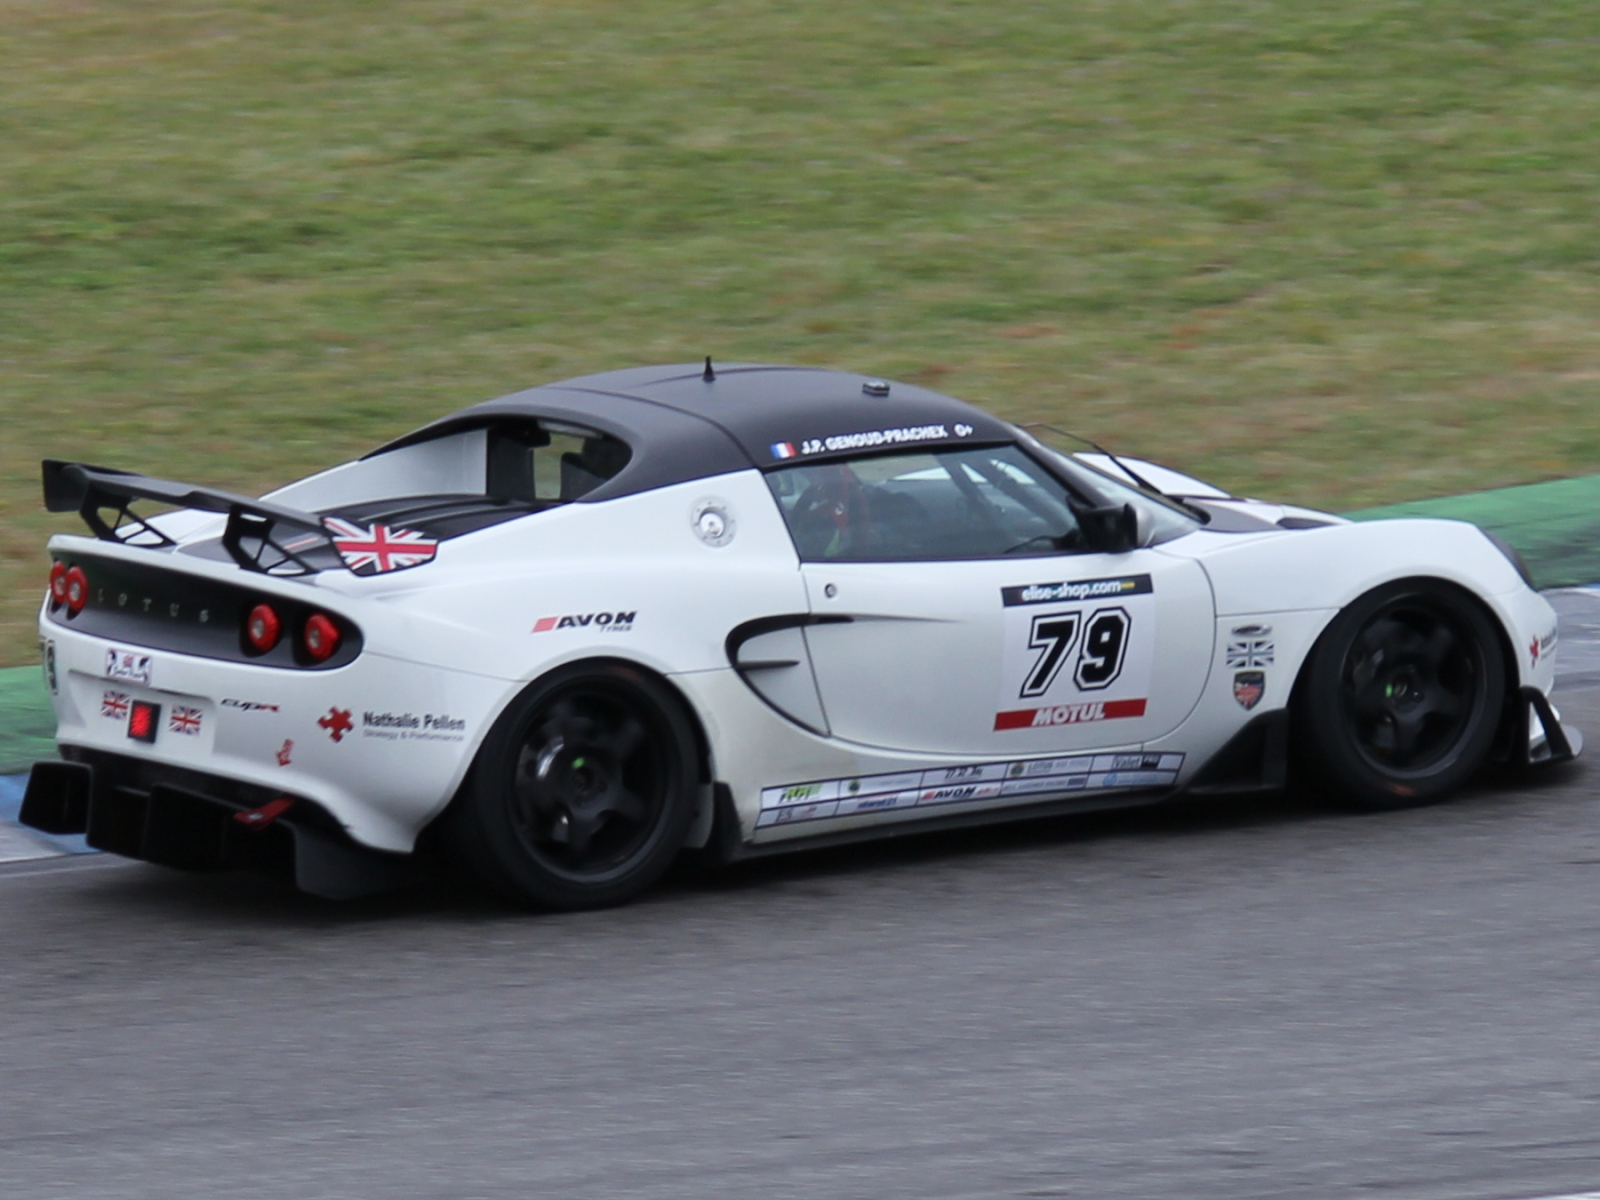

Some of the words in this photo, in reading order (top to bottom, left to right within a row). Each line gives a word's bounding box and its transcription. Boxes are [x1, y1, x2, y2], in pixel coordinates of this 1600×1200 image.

[1021, 580, 1122, 602] elise-shop.com
[98, 588, 209, 623] LOTUS
[555, 610, 638, 629] AVON
[1018, 605, 1132, 699] 79
[1031, 702, 1106, 727] MOTUL
